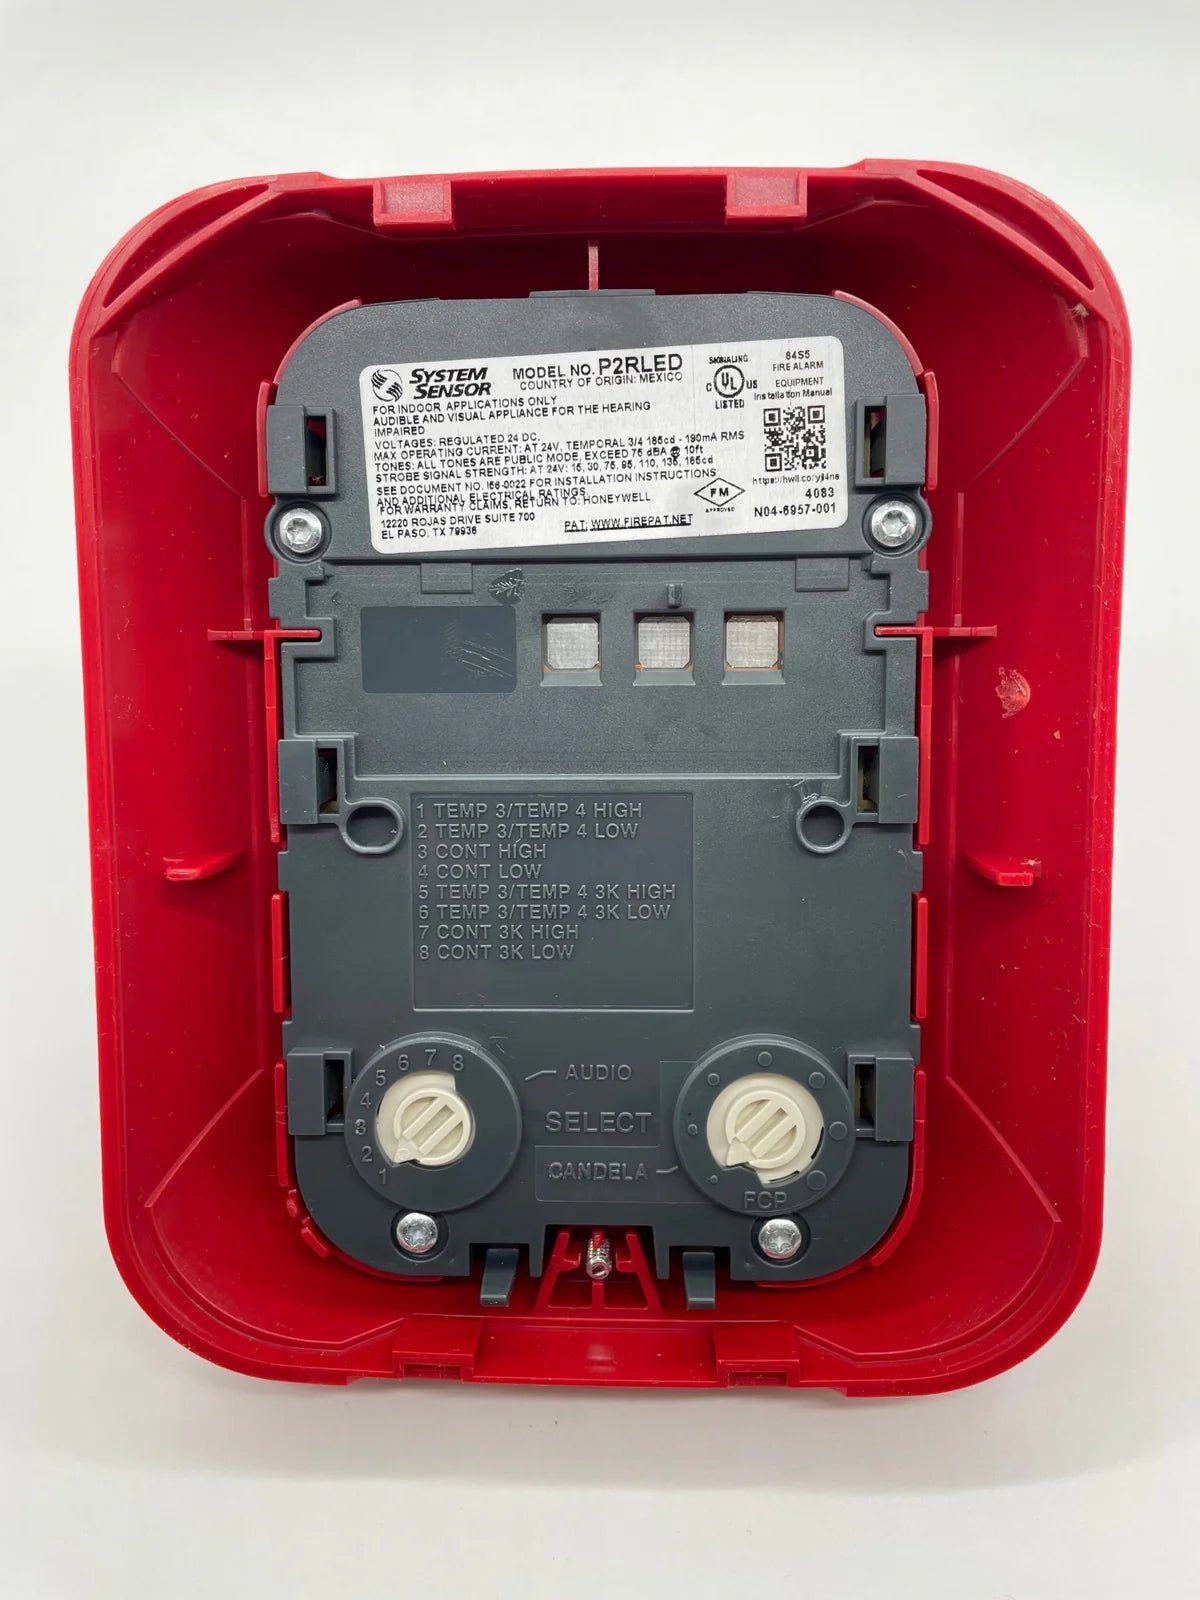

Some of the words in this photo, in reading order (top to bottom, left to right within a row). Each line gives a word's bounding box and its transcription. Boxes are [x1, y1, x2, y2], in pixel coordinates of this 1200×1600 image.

[512, 366, 566, 380] MODEL
[570, 364, 595, 376] NO.
[599, 354, 682, 375] P2RLED
[772, 363, 790, 372] FIRE
[794, 361, 824, 370] ALARM
[410, 367, 488, 384] SYSTEM
[520, 378, 572, 390] COUNTRY
[578, 377, 592, 388] OF
[596, 375, 636, 386] ORIGIN:
[640, 372, 682, 382] MEXICO
[722, 372, 738, 390] UL
[746, 380, 758, 389] US
[776, 377, 824, 388] EQUIPMENT
[414, 382, 492, 400] SENSOR
[802, 388, 832, 396] Manual
[373, 405, 395, 415] FOR
[398, 402, 441, 414] INDOOR
[447, 398, 524, 410] APPLICATIONS
[528, 396, 557, 406] ONLY
[715, 399, 744, 410] LISTED
[374, 415, 419, 426] AUDIBLE
[423, 414, 444, 424] AND
[448, 411, 485, 422] VISUAL
[489, 407, 548, 420] APPLIANCE
[552, 406, 574, 416] FOR
[578, 404, 598, 414] THE
[602, 402, 650, 413] HEARING
[374, 426, 425, 437] IMPAIRED
[374, 451, 396, 460] MAX
[401, 448, 463, 460] OPERATING
[466, 444, 522, 456] CURRENT:
[524, 444, 538, 452] AT
[566, 438, 625, 450] TEMPORAL
[628, 437, 642, 446] 3/4
[720, 430, 744, 440] RMS
[375, 438, 436, 450] VOLTAGES:
[440, 434, 504, 446] REGULATED
[508, 434, 518, 442] 24
[375, 462, 414, 472] TONES:
[417, 460, 436, 470] ALL
[440, 458, 476, 468] TONES
[480, 456, 500, 466] ARE
[504, 454, 543, 464] PUBLIC
[546, 452, 581, 462] MODE,
[585, 449, 628, 460] EXCEED
[646, 447, 667, 456] dBA
[684, 445, 704, 454] 10ft
[376, 472, 420, 483] STROBE
[424, 470, 461, 480] SIGNAL
[465, 466, 527, 478] STRENGTH:
[530, 465, 543, 474] AT
[546, 464, 568, 474] 24V:
[640, 458, 658, 468] 110,
[376, 486, 396, 496] SEE
[400, 482, 461, 494] DOCUMENT
[465, 482, 484, 491] NO.
[530, 478, 552, 488] FOR
[555, 474, 632, 486] INSTALLATION
[636, 468, 716, 482] INSTRUCTIONS
[377, 498, 399, 506] AND
[402, 494, 465, 505] ADDITIONAL
[470, 490, 535, 502] ELECTRICAL
[710, 488, 728, 498] FM
[805, 487, 834, 498] 4083
[380, 506, 402, 515] FOR
[404, 502, 464, 514] WARRANTY
[470, 500, 511, 510] CLAIMS,
[515, 497, 559, 508] RETURN
[563, 496, 580, 505] TO:
[584, 492, 650, 504] HONEYWELL
[754, 502, 836, 517] N04-6957-001
[382, 519, 408, 528] 12220
[412, 516, 446, 526] ROJAS
[450, 515, 481, 524] DRIVE
[485, 513, 516, 523] SUITE
[518, 512, 535, 521] 700
[590, 514, 693, 530] WWW.FIREPAT.NET
[382, 530, 394, 540] EL
[398, 528, 430, 538] PASO,
[433, 528, 446, 536] TX
[416, 803, 424, 818] 1
[434, 803, 488, 818] TEMP
[496, 803, 569, 818] 3/TEMP
[575, 803, 586, 818] 4
[594, 803, 642, 818] HIGH
[418, 823, 428, 838] 2
[436, 823, 488, 838] TEMP
[496, 823, 569, 838] 3/TEMP
[576, 823, 587, 838] 4
[595, 823, 638, 838] LOW
[418, 844, 428, 859] 3
[436, 844, 491, 859] CONT
[498, 844, 546, 859] HIGH
[418, 864, 428, 878] 4
[436, 864, 491, 878] CONT
[500, 864, 542, 878] LOW
[418, 884, 428, 900] 5
[437, 884, 490, 900] TEMP
[498, 884, 570, 900] 3/TEMP
[577, 884, 588, 900] 4
[595, 884, 620, 900] 3K
[628, 884, 676, 900] HIGH
[418, 904, 428, 920] 6
[437, 904, 490, 920] TEMP
[498, 904, 570, 920] 3/TEMP
[577, 904, 588, 920] 4
[595, 904, 620, 920] 3K
[628, 904, 670, 920] LOW
[419, 924, 430, 940] 7
[437, 924, 492, 940] CONT
[499, 924, 523, 940] 3K
[532, 924, 578, 940] HIGH
[419, 944, 430, 960] 8
[437, 944, 492, 960] CONT
[499, 944, 523, 960] 3K
[532, 944, 574, 960] LOW
[398, 1054, 409, 1070] 6
[425, 1049, 436, 1066] 7
[452, 1054, 464, 1071] 8
[376, 1070, 386, 1086] 5
[565, 1064, 632, 1080] AUDIO
[360, 1092, 372, 1108] 4
[355, 1119, 366, 1135] 3
[546, 1111, 652, 1133] SELECT
[361, 1146, 372, 1162] 2
[378, 1168, 386, 1184] 1
[549, 1162, 648, 1180] CANDELA
[744, 1191, 787, 1209] FCP
